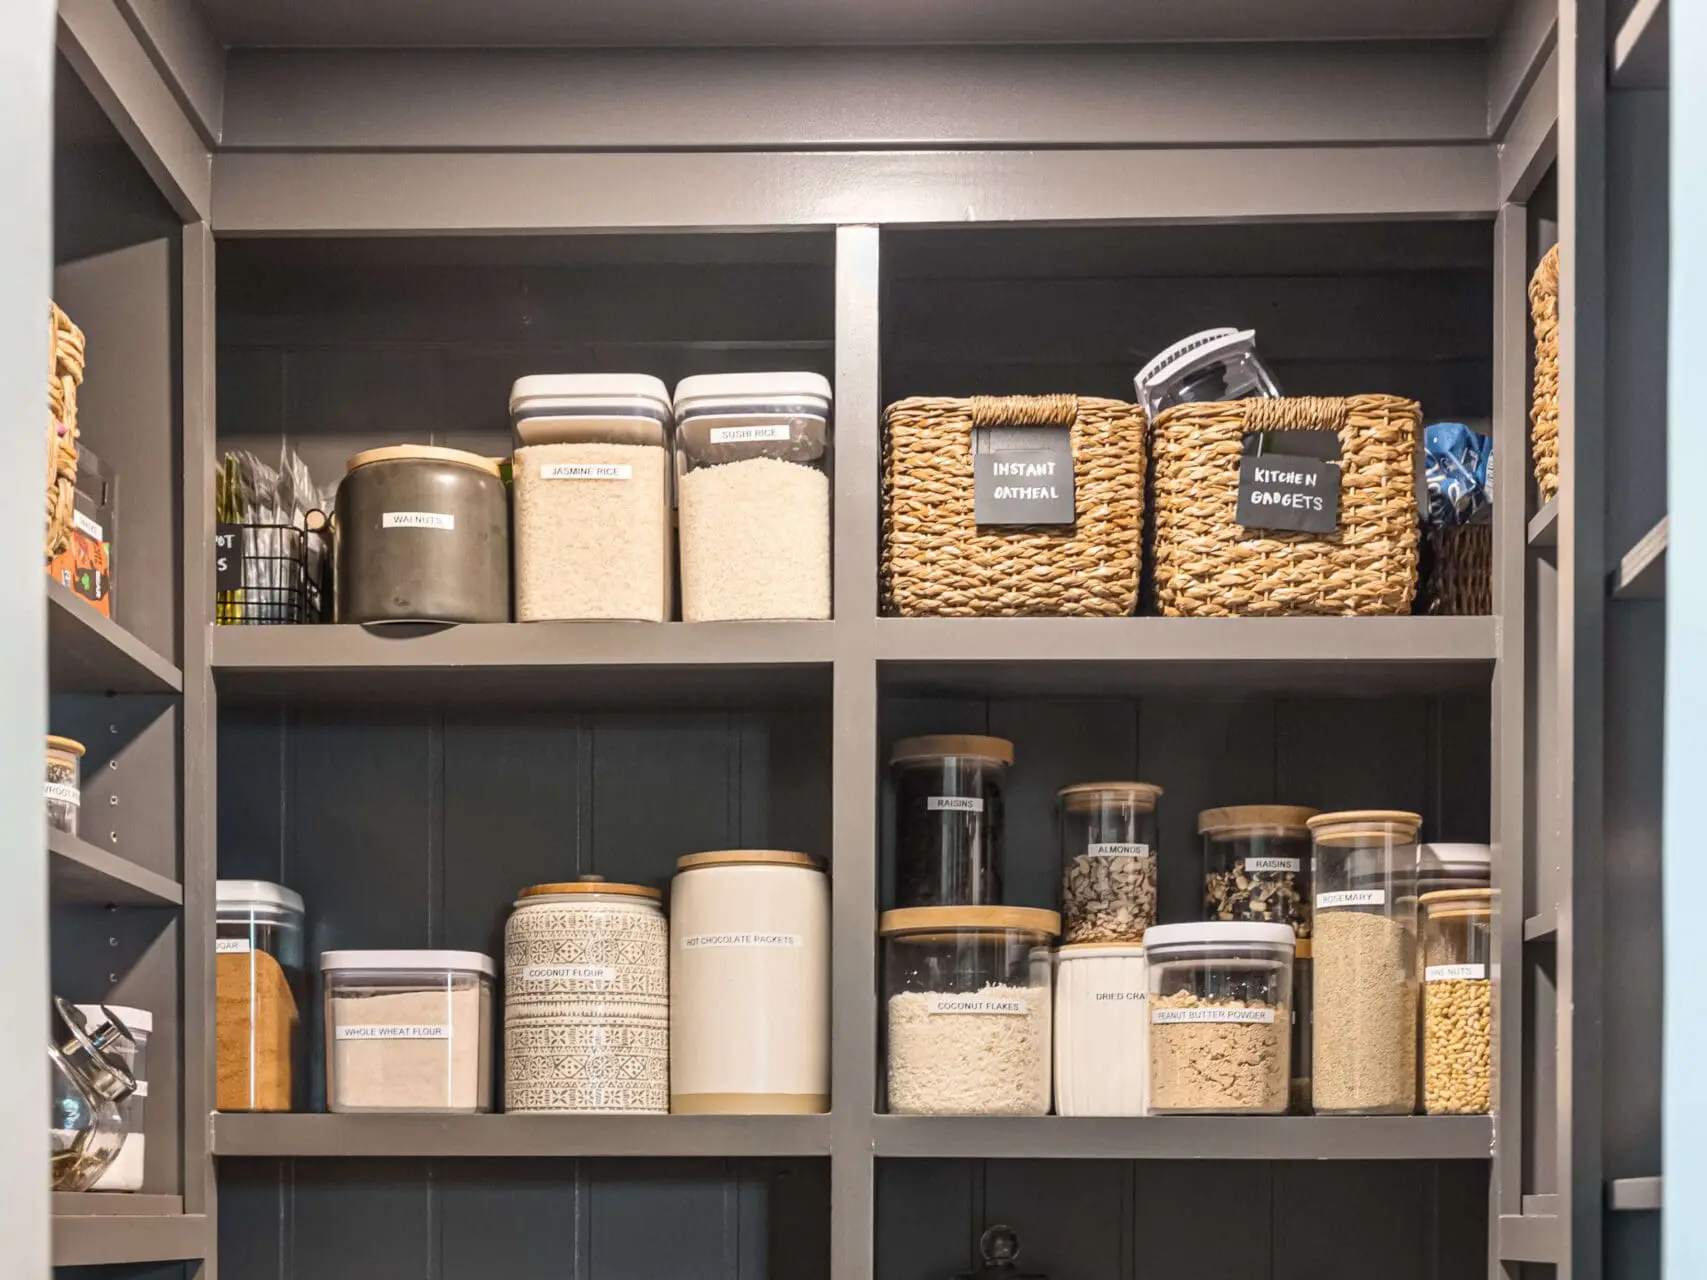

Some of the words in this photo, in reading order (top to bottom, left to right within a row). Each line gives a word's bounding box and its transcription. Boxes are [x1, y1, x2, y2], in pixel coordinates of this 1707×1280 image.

[721, 429, 753, 440] SUSHI
[755, 427, 776, 437] RICE
[552, 467, 593, 476] JASMINE
[596, 467, 621, 477] RICE
[993, 461, 1057, 477] INSTANT
[1254, 467, 1318, 487] KITCHEN
[993, 486, 1060, 500] OATMEAL
[1250, 490, 1324, 511] GADGETS
[393, 515, 442, 525] WALNUTS
[937, 799, 975, 808] RAISINS
[1097, 846, 1142, 854] ALMONDS
[1256, 860, 1292, 868] RAISINS
[1322, 893, 1373, 904] ROSEMARY
[686, 937, 700, 947] HOT
[701, 935, 752, 945] CHOCOLATE
[754, 935, 796, 945] PACKETS
[529, 969, 570, 977] COCONUT
[572, 968, 605, 977] FLOUR
[1447, 967, 1473, 976] NUTS
[1096, 993, 1124, 1001] DRIED
[937, 1002, 983, 1010] COCONUT
[986, 1002, 1019, 1011] FLAKES
[1158, 1011, 1187, 1020] PEANUT
[1189, 1010, 1225, 1019] BUTTER
[1227, 1010, 1267, 1019] POWDER
[344, 1027, 377, 1036] WHOLE
[378, 1027, 411, 1036] WHEAT
[412, 1027, 443, 1036] FLOUR
